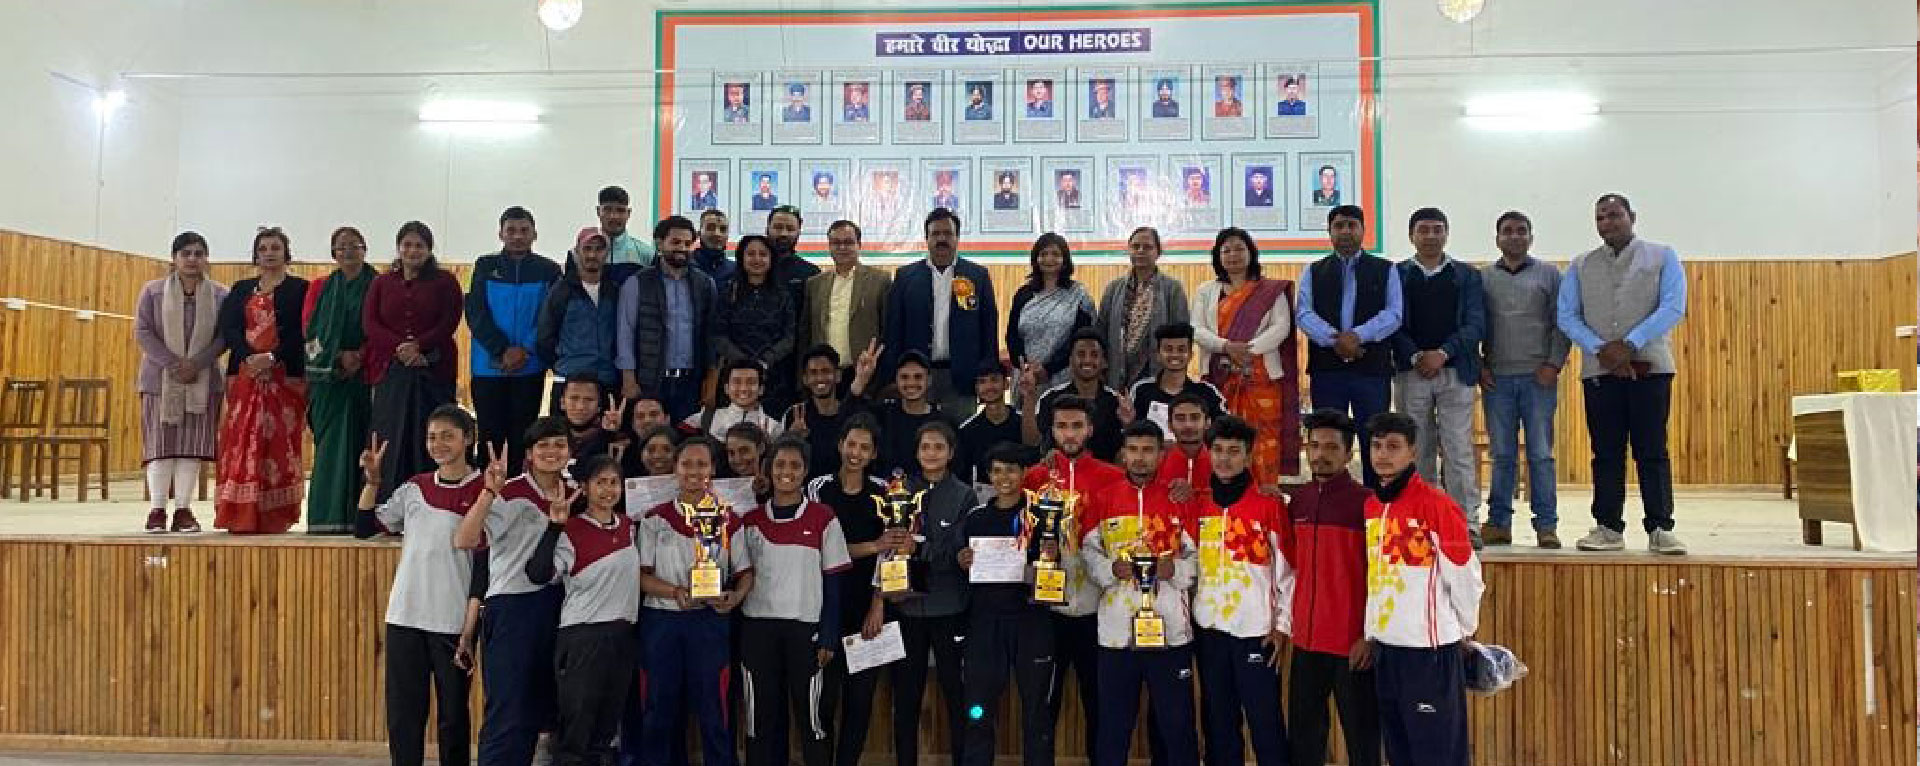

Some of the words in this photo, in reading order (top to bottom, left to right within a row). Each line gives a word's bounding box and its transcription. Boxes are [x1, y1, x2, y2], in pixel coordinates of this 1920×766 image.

[882, 33, 925, 54] हमारे
[929, 33, 961, 54] वीर
[1023, 33, 1064, 50] OUR
[1069, 31, 1143, 50] HEROES
